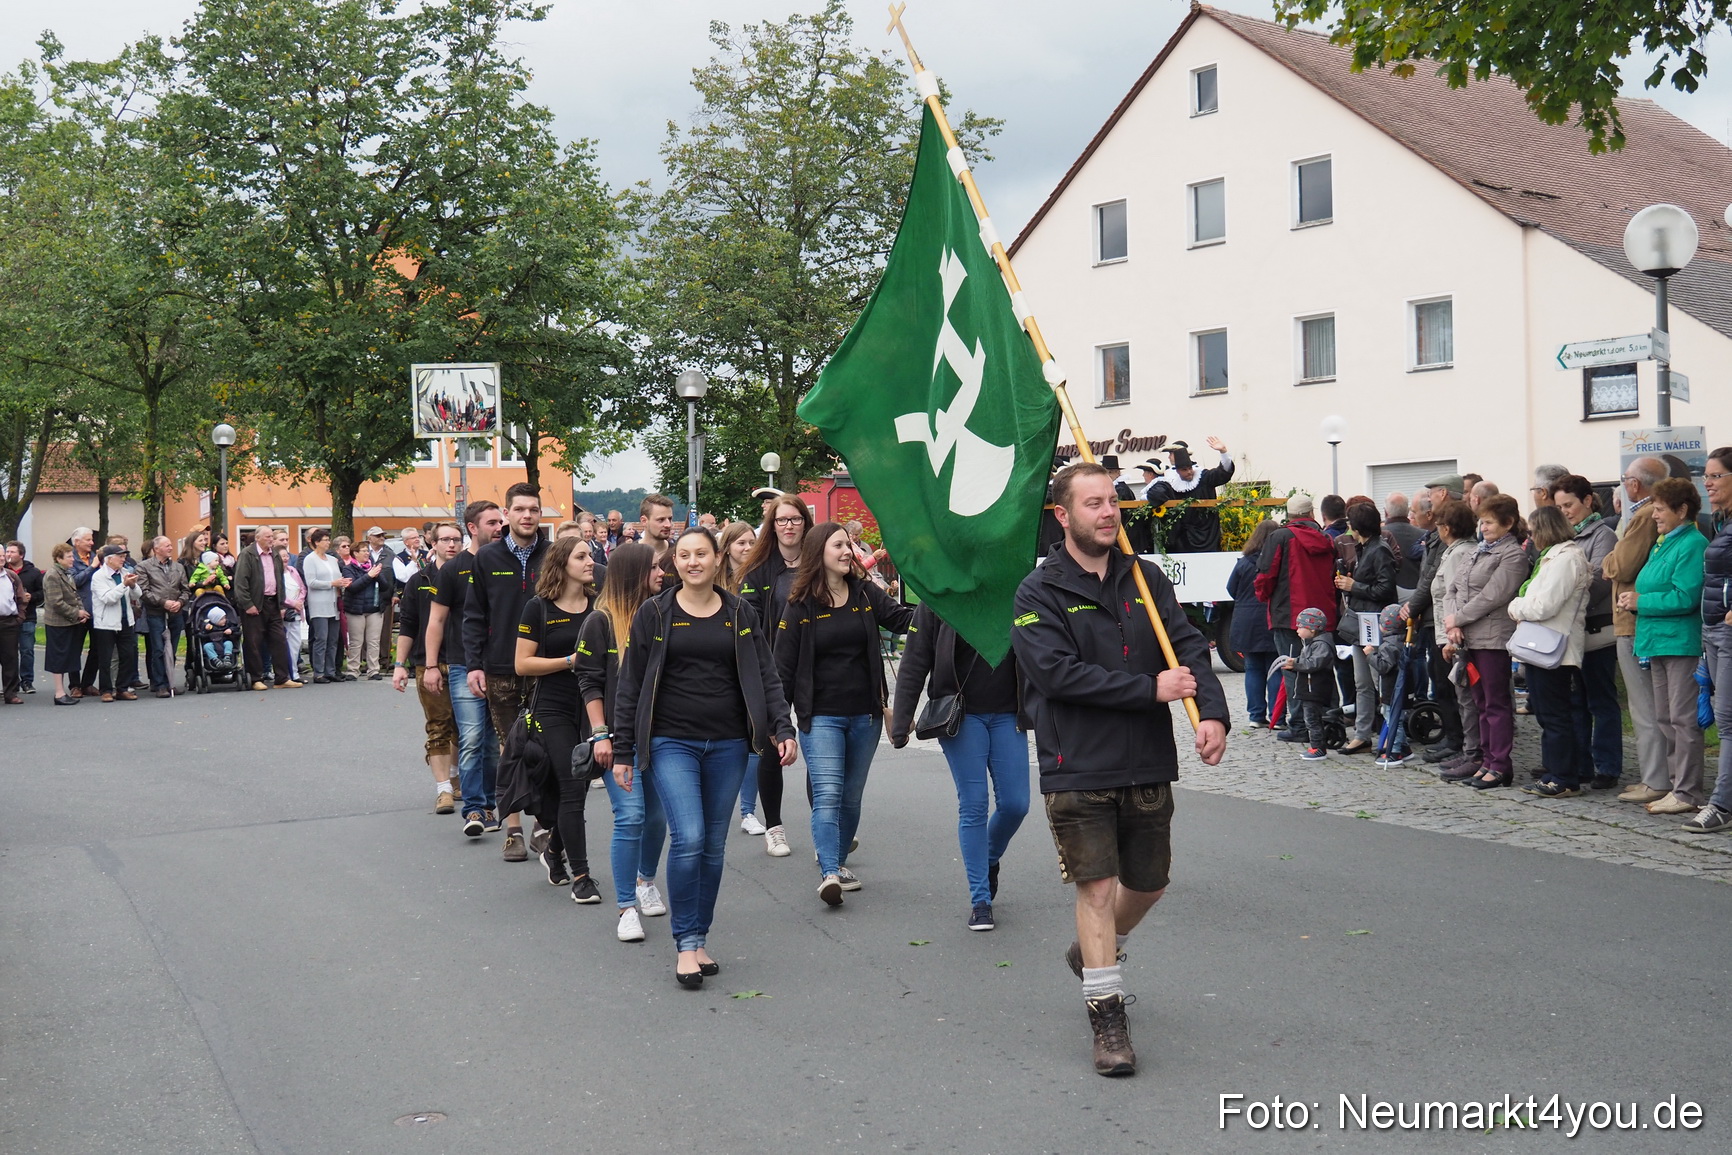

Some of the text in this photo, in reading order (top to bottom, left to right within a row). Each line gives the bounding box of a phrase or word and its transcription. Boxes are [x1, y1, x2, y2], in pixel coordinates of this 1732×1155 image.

[1573, 347, 1606, 357] Neumarkt
[1115, 428, 1167, 454] Sonne
[1636, 443, 1662, 452] FREIE
